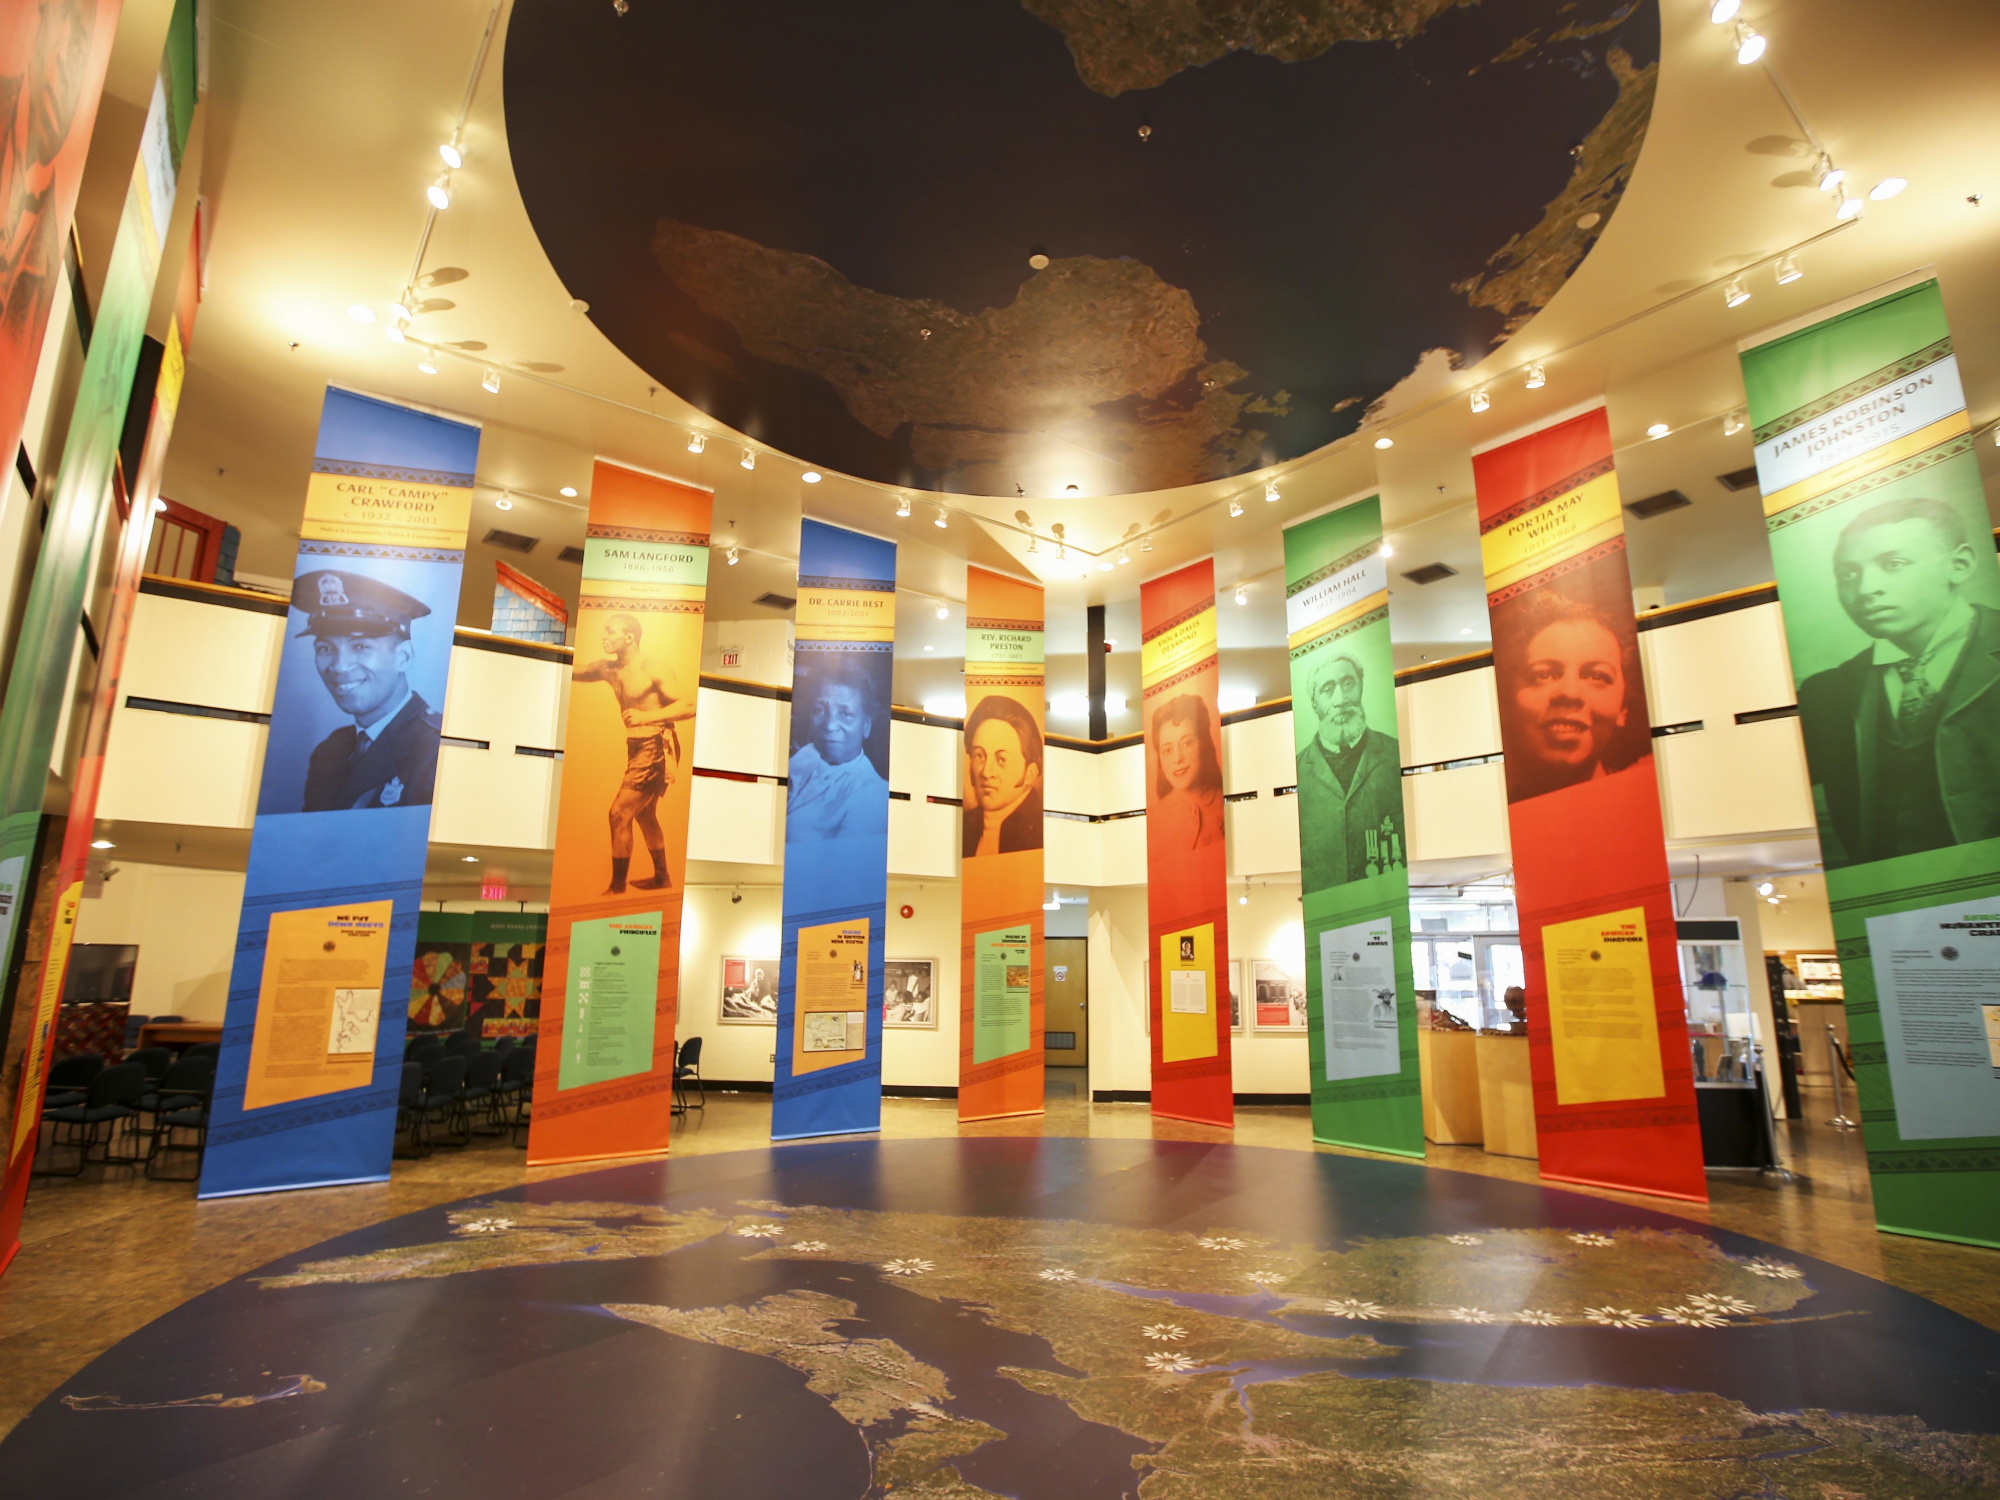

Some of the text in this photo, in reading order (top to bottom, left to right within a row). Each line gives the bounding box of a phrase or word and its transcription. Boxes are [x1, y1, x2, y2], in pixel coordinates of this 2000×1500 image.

[1774, 374, 1934, 458] JAMES ROBINSON
[1806, 403, 1906, 458] JOHNSTON
[336, 482, 449, 500] CARL "CAMPY"
[351, 496, 435, 512] CRAWFORD
[361, 510, 391, 521] 1932
[406, 514, 438, 525] 2003
[1508, 493, 1584, 537] PORTIA MAY
[1528, 512, 1569, 539] WHITE
[604, 548, 694, 563] SAM LANGFORD
[623, 562, 675, 574] 1886-1956
[1302, 569, 1367, 607] WILLIAM HALL
[809, 597, 885, 608] DR. CARRIE BEST
[981, 633, 1032, 642] REV. RICHARD
[1157, 620, 1200, 647] VIOLA DAVIS
[1161, 631, 1197, 655] DESMOND
[723, 653, 739, 666] EXIT
[482, 885, 506, 900] EXIT
